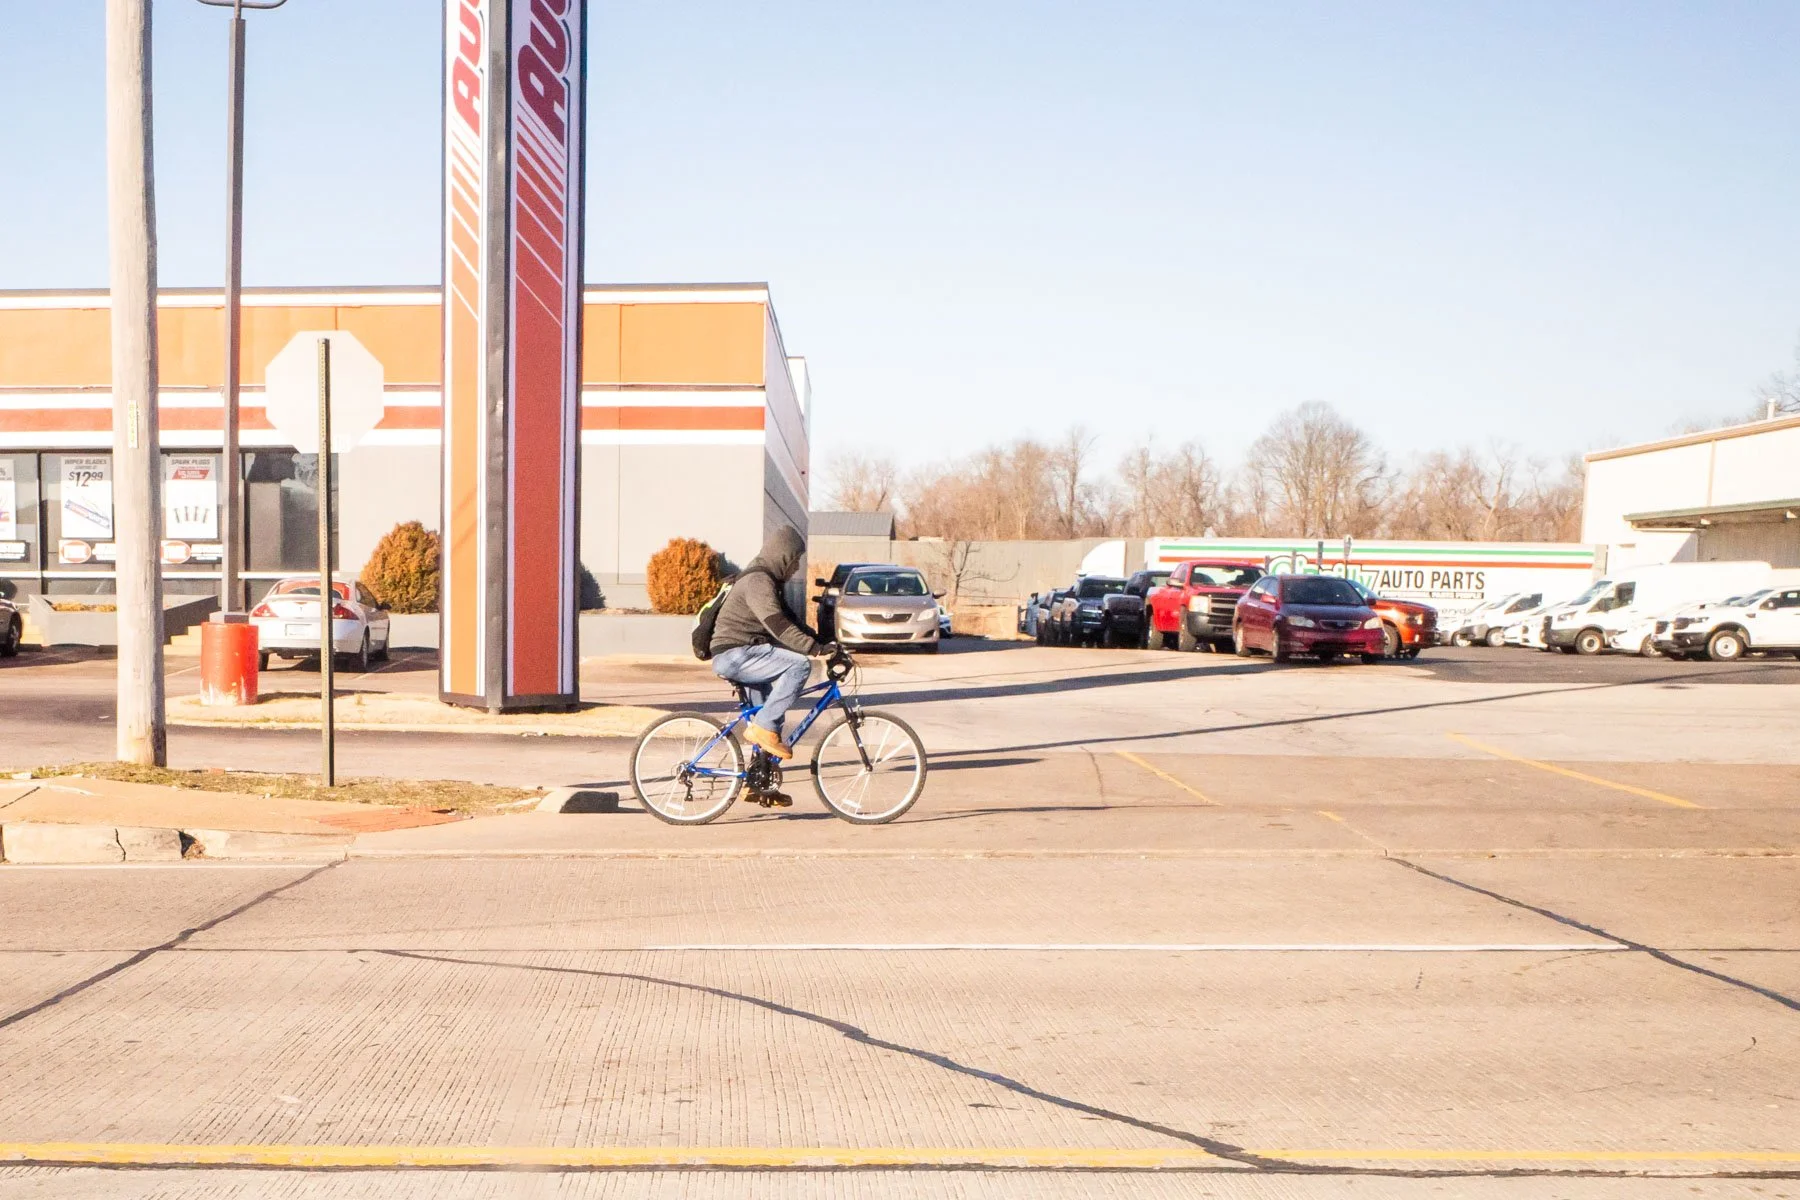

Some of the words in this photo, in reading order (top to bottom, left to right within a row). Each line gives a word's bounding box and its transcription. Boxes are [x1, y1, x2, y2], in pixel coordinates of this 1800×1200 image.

[452, 0, 482, 138] AU
[1380, 569, 1424, 589] AUTO
[1430, 571, 1485, 590] PARTS
